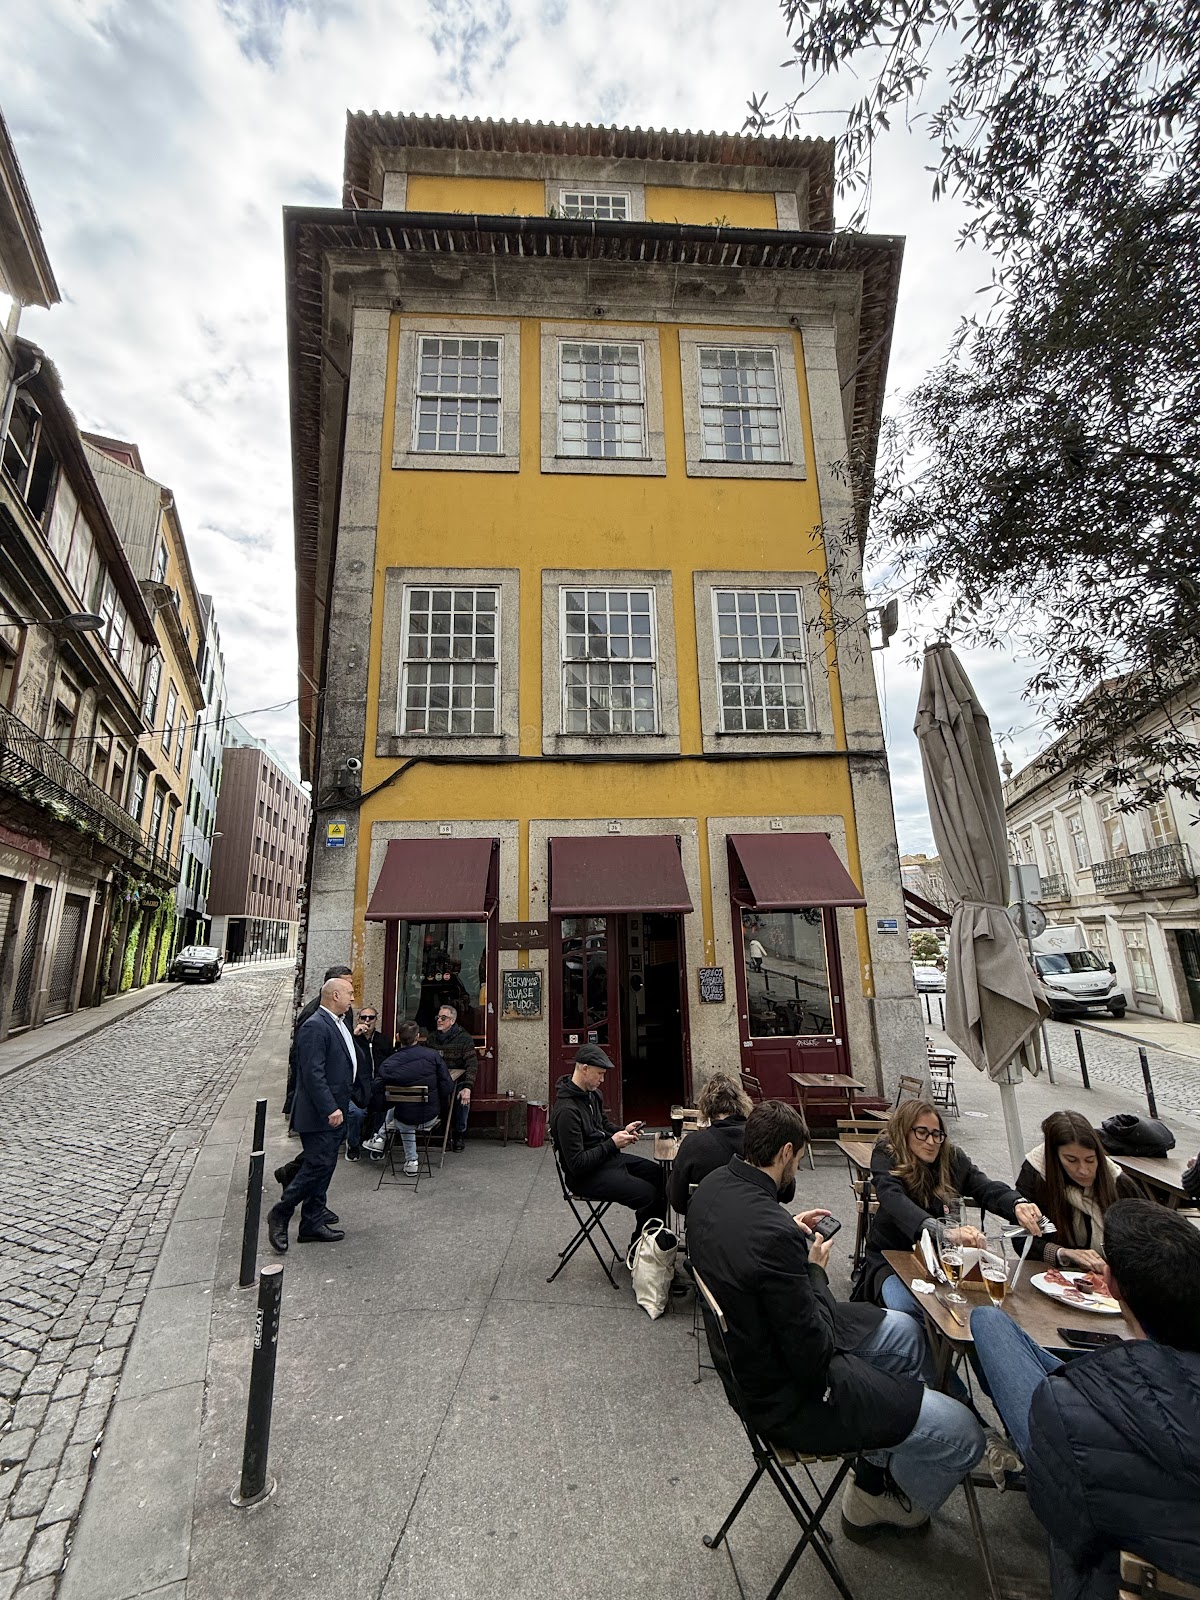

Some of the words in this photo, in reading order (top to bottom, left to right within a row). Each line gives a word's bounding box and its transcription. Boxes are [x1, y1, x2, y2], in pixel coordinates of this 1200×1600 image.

[507, 976, 539, 988] SERVIMOS
[507, 987, 534, 999] QUASE
[508, 999, 532, 1009] TUDO
